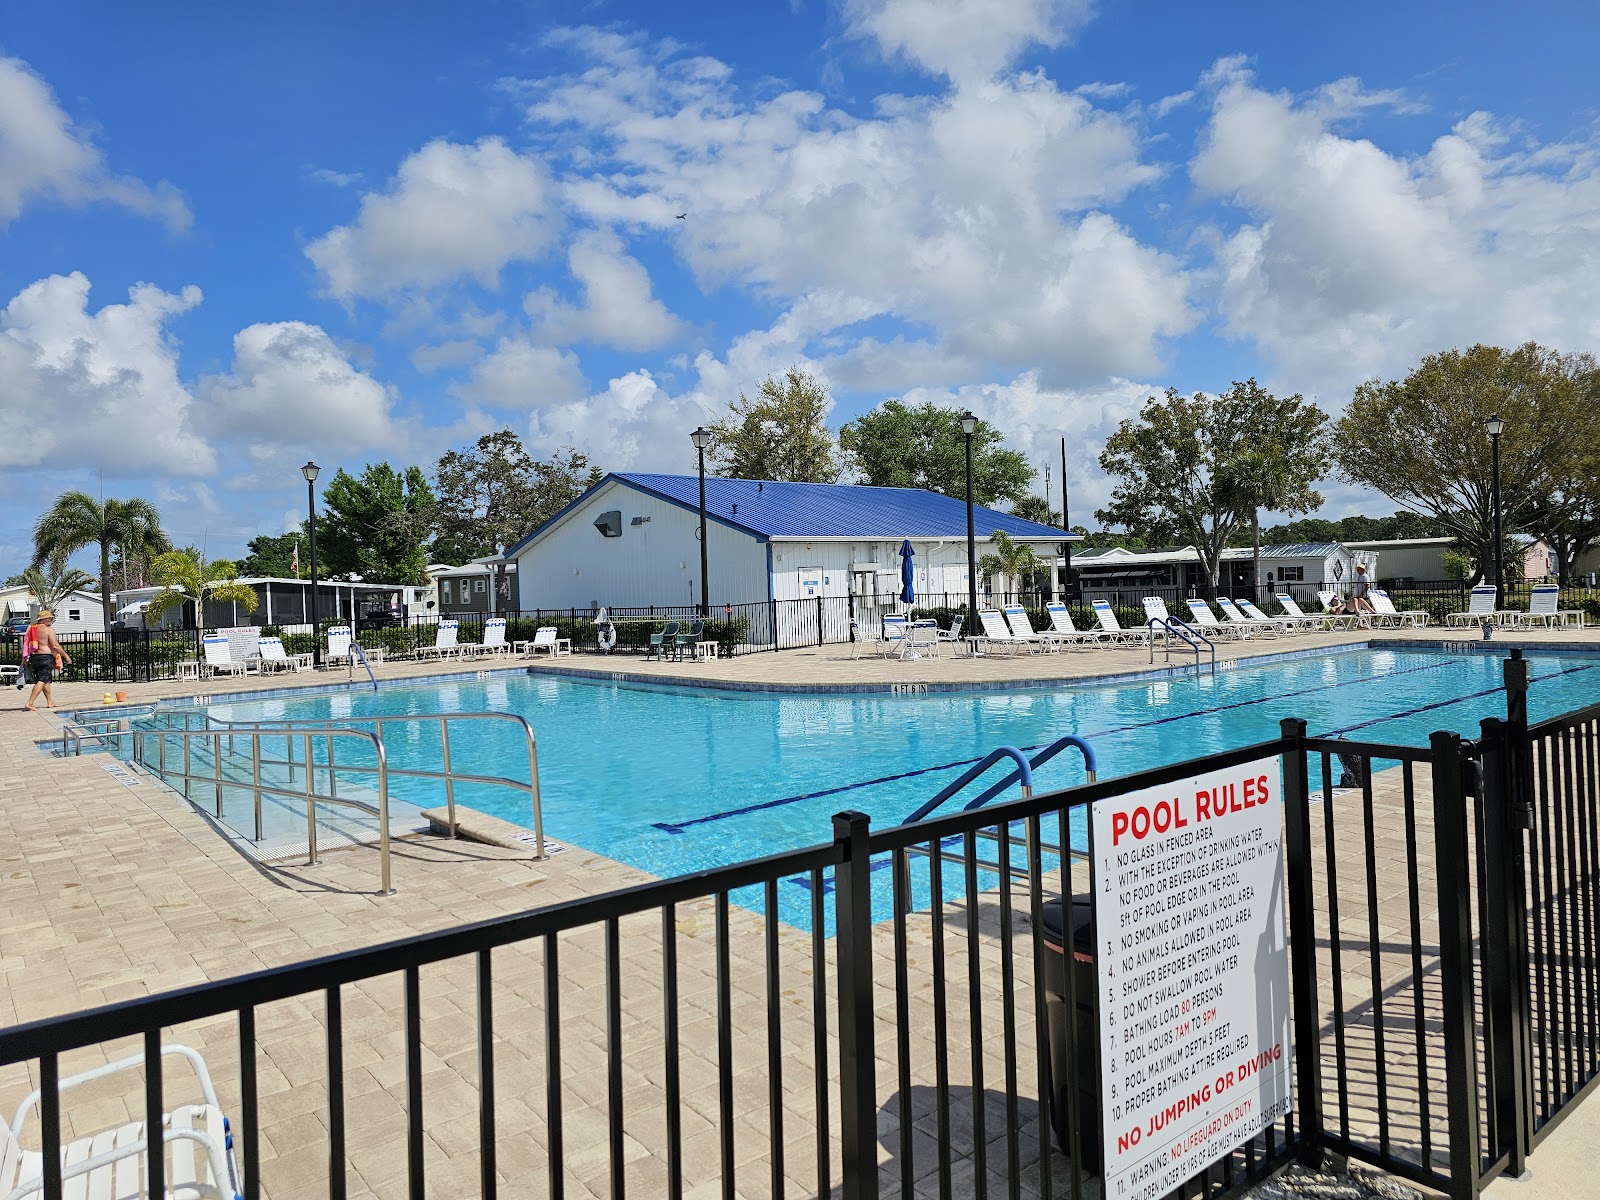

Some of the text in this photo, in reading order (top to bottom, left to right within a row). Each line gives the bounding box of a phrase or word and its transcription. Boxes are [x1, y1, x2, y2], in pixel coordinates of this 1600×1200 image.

[901, 684, 908, 694] FT
[919, 684, 926, 695] IN
[1112, 776, 1268, 846] POOL RULES
[1105, 826, 1213, 871] 1. NO GLASS IN FENCED AREA
[1105, 828, 1262, 892] 2. WITH THE EXCEPTION OF DRINKING WATER
[1120, 892, 1131, 907] NO
[1134, 883, 1154, 902] FOOD
[1157, 879, 1167, 893] OR
[1169, 864, 1209, 889] BEVERAGES
[1212, 858, 1223, 874] ARE
[1226, 848, 1255, 869] ALLOWED
[1108, 885, 1254, 956] 3. NO SMOKING OR VAPING IN POOL AREA
[1121, 872, 1239, 928] 5ft OF POOL EDGE OR IN THE POOL
[1109, 907, 1252, 978] 4. NO ANIMALS ALLOWED IN POOL AREA
[1109, 933, 1240, 1002] 5. SHOWER BEFORE ENTERING POOL
[1110, 955, 1237, 1026] 6. DO NOT SWALLOW POOL WATER
[1111, 983, 1222, 1050] 7. BATHING LOAD 80 PERSONS
[1111, 1008, 1216, 1073] 8. POOL HOURS 7AM TO 9PM
[1112, 1022, 1230, 1098] 9. POOL MAXIMUM DEPTH 5 FEET
[1113, 1034, 1248, 1122] 10. PROPER BATHING ATTIRE REQUIRED
[1118, 1044, 1281, 1155] NO JUMPING OR DIVING
[1118, 1098, 1252, 1195] 11. WARNING: NO LIFEGUARD ON DUTY
[1160, 1167, 1179, 1191] UNDER
[1181, 1162, 1186, 1177] 16
[1187, 1155, 1197, 1172] YRS
[1199, 1149, 1206, 1165] OF
[1208, 1141, 1217, 1159] AGE
[1219, 1132, 1232, 1151] MUST
[1234, 1123, 1246, 1143] HAVE
[1249, 1113, 1263, 1132] ADULT
